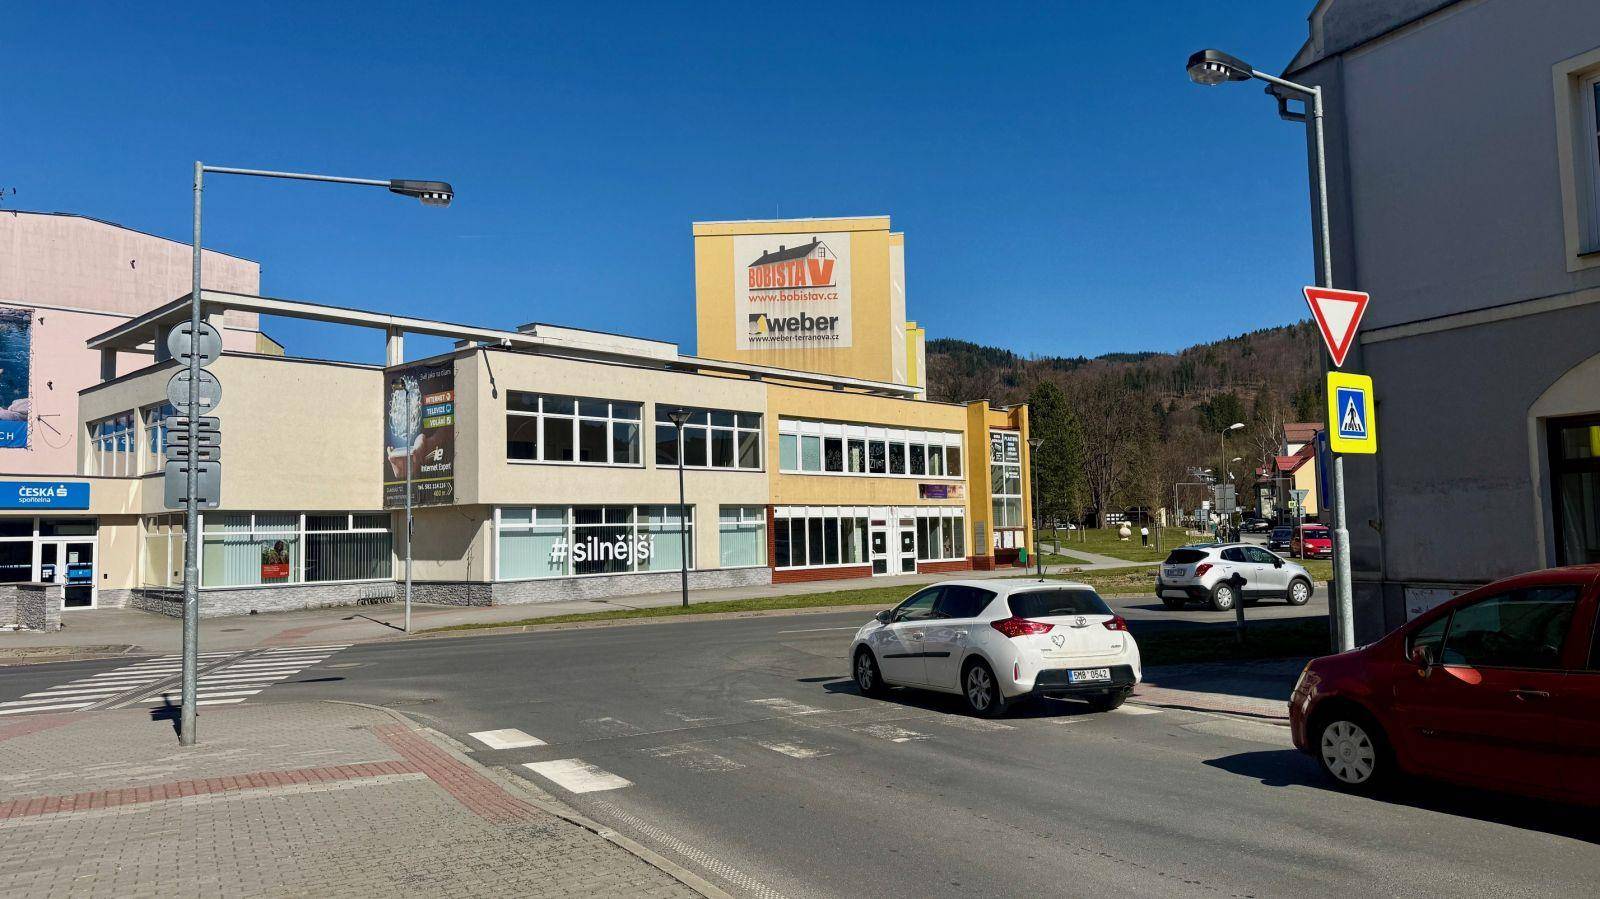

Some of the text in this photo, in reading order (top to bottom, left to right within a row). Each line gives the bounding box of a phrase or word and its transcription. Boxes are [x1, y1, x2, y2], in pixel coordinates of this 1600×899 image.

[748, 258, 835, 288] BOBISTAV
[748, 290, 839, 303] www.bobistav.cz
[765, 311, 839, 333] weber
[748, 333, 840, 343] www.weber-terranova.cz
[421, 464, 438, 472] Internet
[19, 485, 54, 497] ČESKÁ
[550, 534, 656, 566] #silnější
[1091, 669, 1107, 679] 0542
